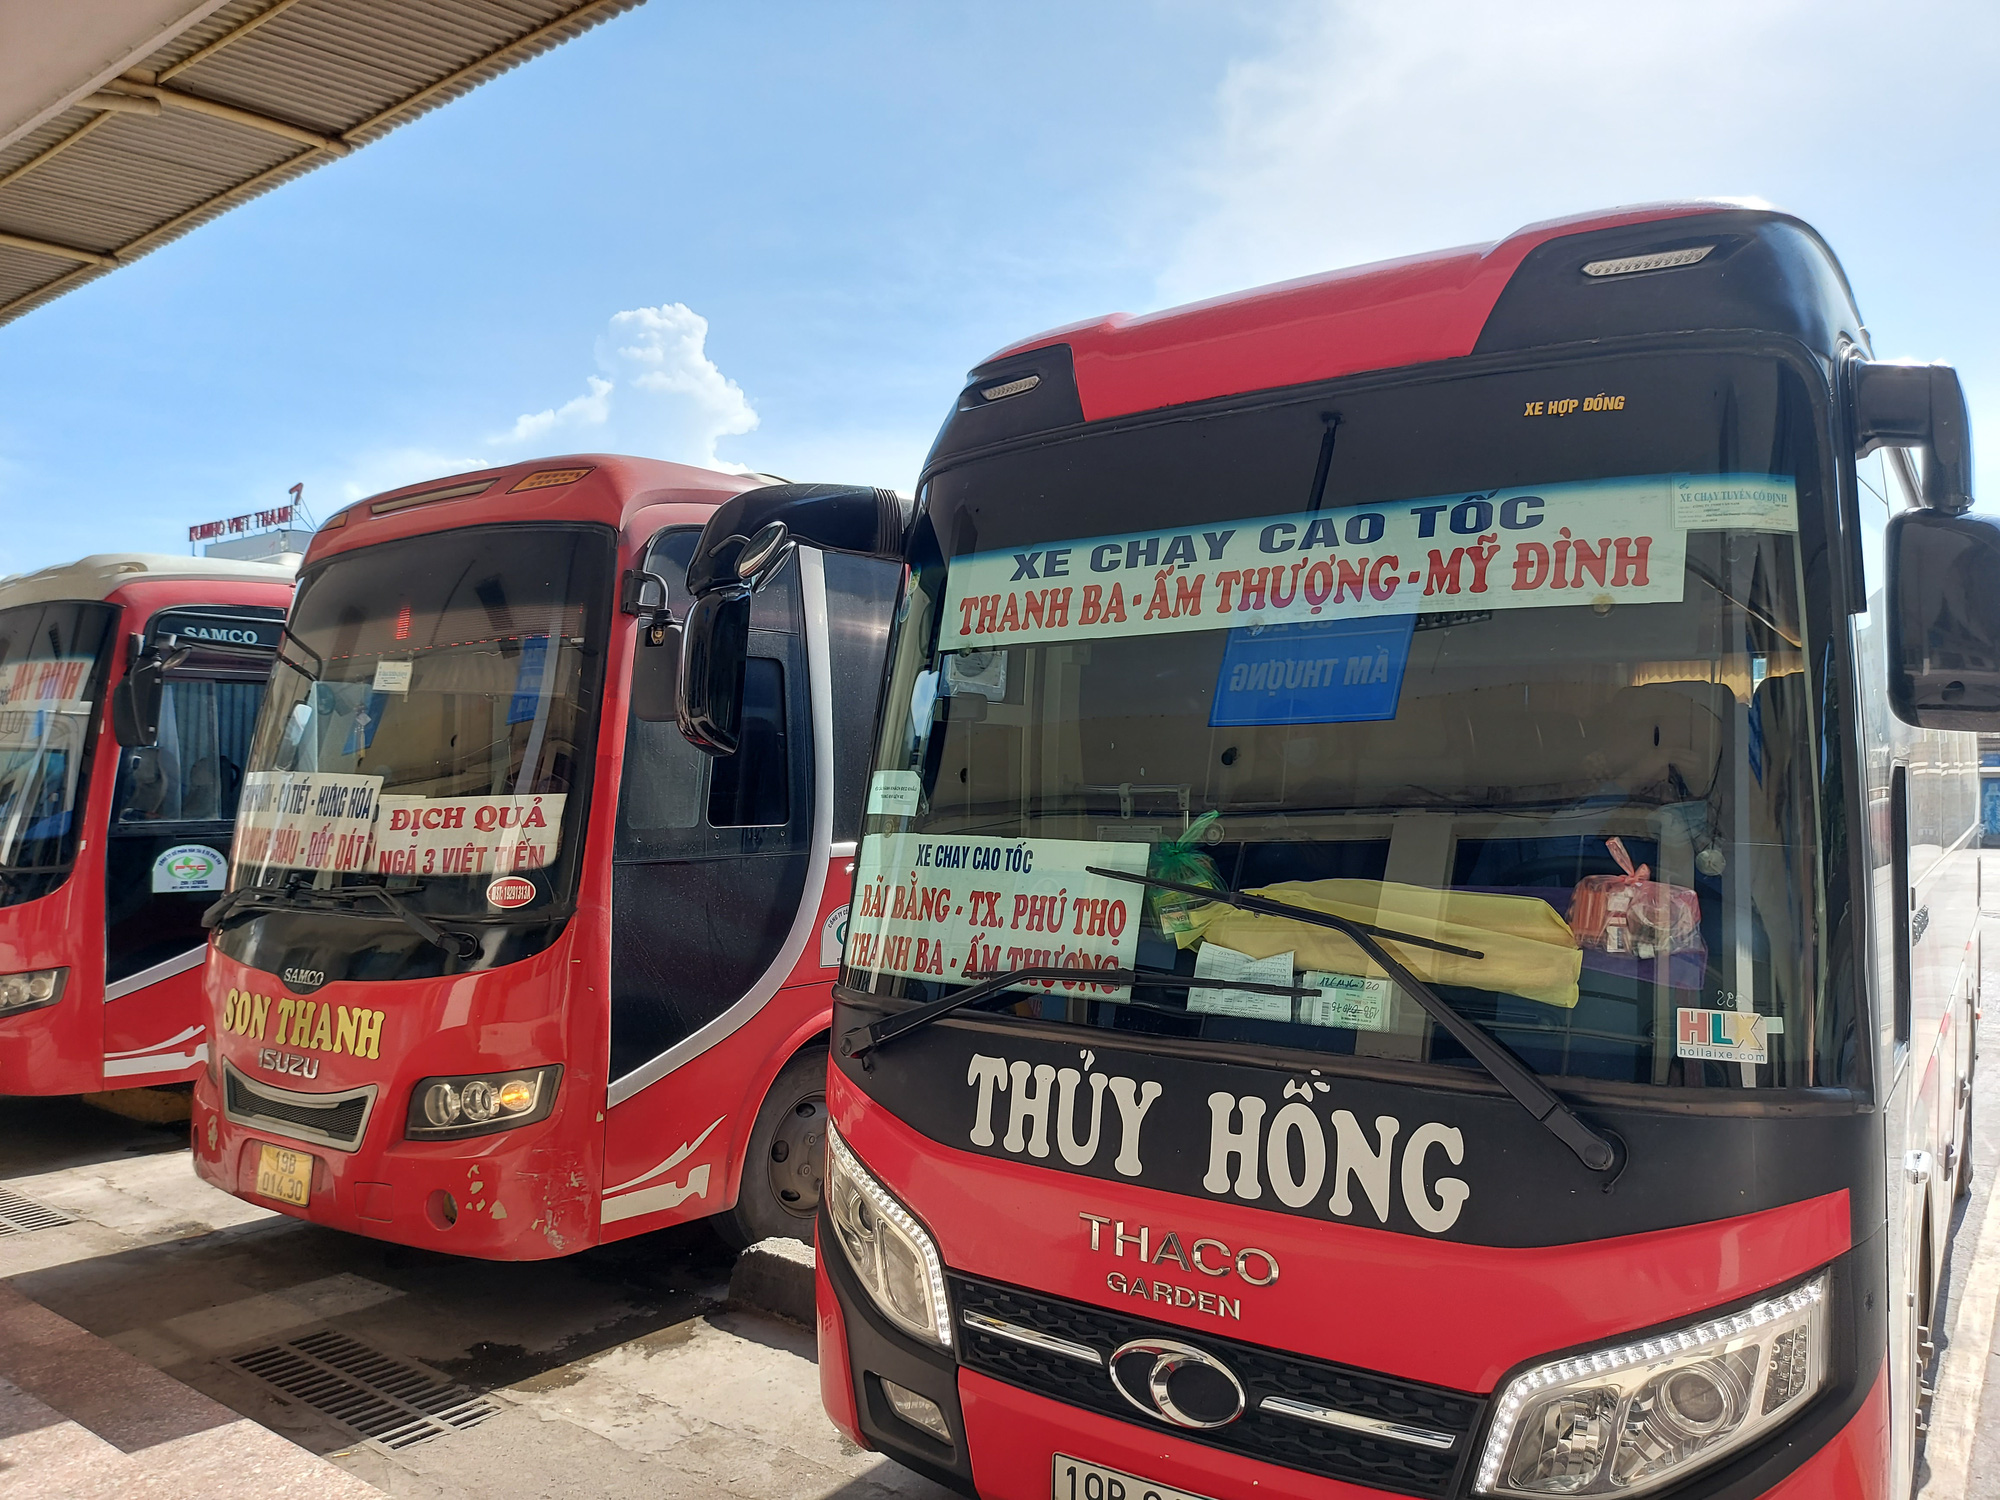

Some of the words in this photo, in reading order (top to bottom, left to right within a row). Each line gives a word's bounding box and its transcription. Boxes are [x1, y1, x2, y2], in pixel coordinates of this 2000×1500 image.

[1524, 402, 1544, 416] XE
[1547, 398, 1579, 417] HỢP
[1009, 549, 1072, 582] XE
[1089, 530, 1237, 570] CHẠY
[1257, 512, 1386, 554] CAO
[1410, 488, 1545, 539] TỐC
[959, 587, 1074, 636] THANH
[1511, 527, 1653, 591] ĐÌNH
[183, 626, 258, 645] SAMCO
[347, 780, 374, 819] HÓA
[390, 806, 466, 837] ĐỊCH
[474, 796, 547, 832] QUẢ
[378, 844, 417, 875] NGÃ
[422, 848, 436, 874] 3
[916, 844, 932, 866] XE
[935, 845, 970, 869] CHAY
[972, 846, 1001, 871] CAO
[1005, 841, 1034, 874] TỐC
[969, 890, 1004, 928] TX.
[1010, 888, 1068, 933] PHÚ
[1072, 897, 1127, 946] THỌ
[851, 932, 912, 972] THANH
[913, 937, 944, 975] BA
[961, 932, 1002, 980] ẤM
[283, 967, 325, 986] SAMCO
[275, 997, 385, 1060] THANH
[1680, 1011, 1764, 1050] HLX
[257, 1047, 320, 1080] ISUZU
[967, 1049, 1162, 1177] THỦY
[1203, 1069, 1470, 1233] HỒNG
[276, 1150, 297, 1175] 19B
[262, 1171, 304, 1201] 014.30
[1079, 1211, 1280, 1288] THACO
[1106, 1271, 1242, 1321] GARDEN
